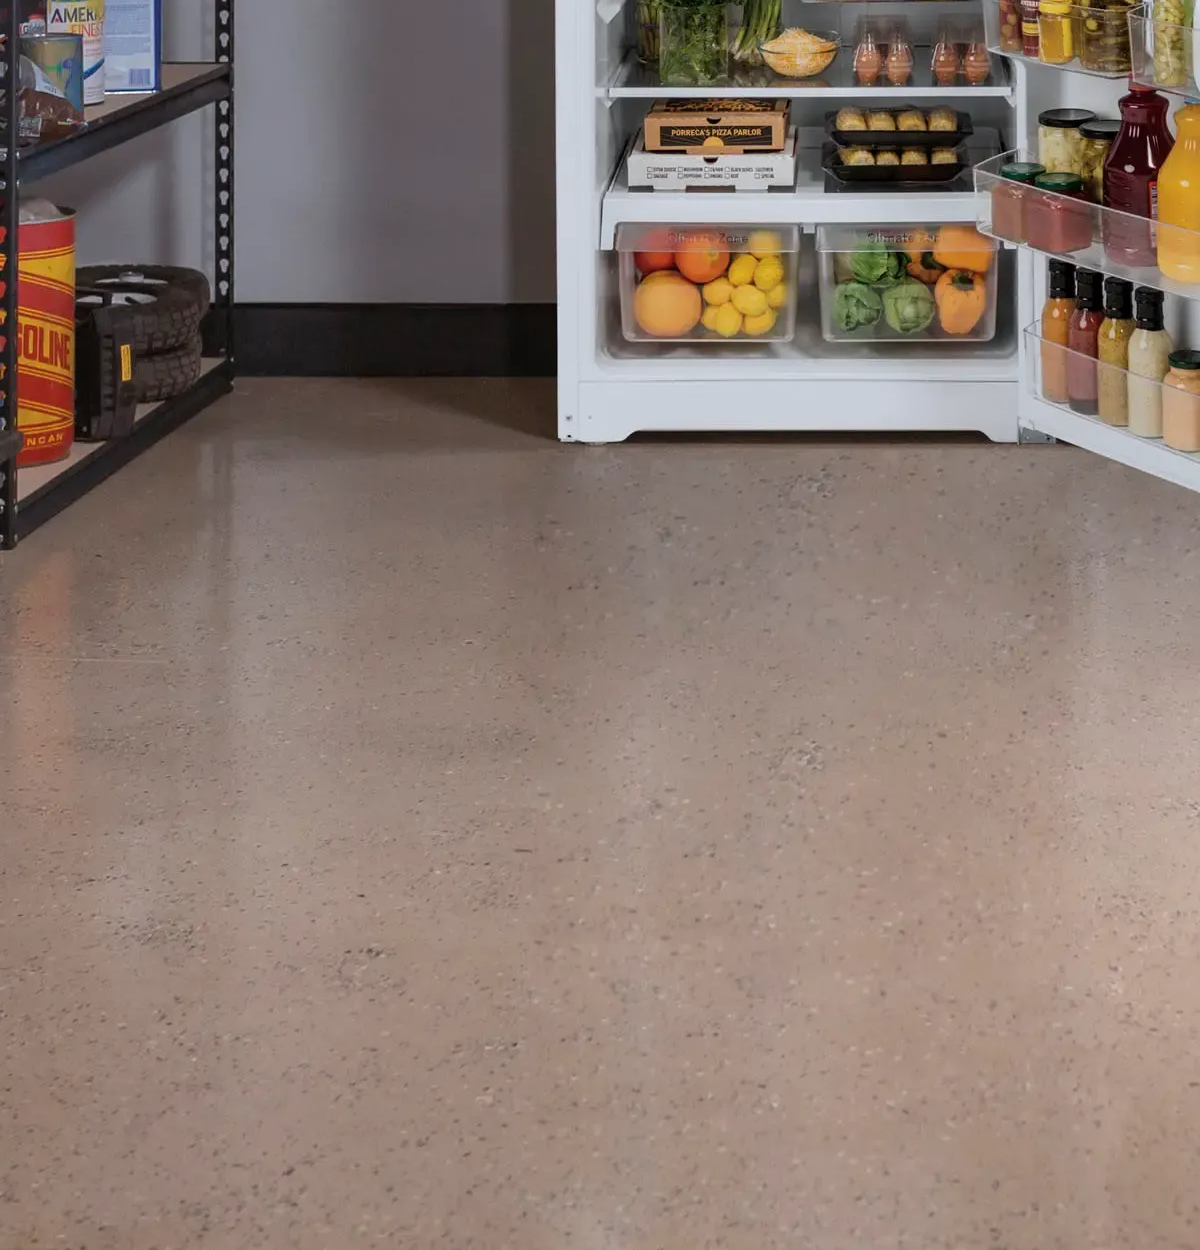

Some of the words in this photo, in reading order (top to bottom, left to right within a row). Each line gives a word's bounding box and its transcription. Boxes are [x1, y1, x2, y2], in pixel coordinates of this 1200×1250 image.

[671, 128, 710, 137] PORRECA'S
[712, 128, 732, 136] PIZZA
[733, 128, 762, 136] PARLOR
